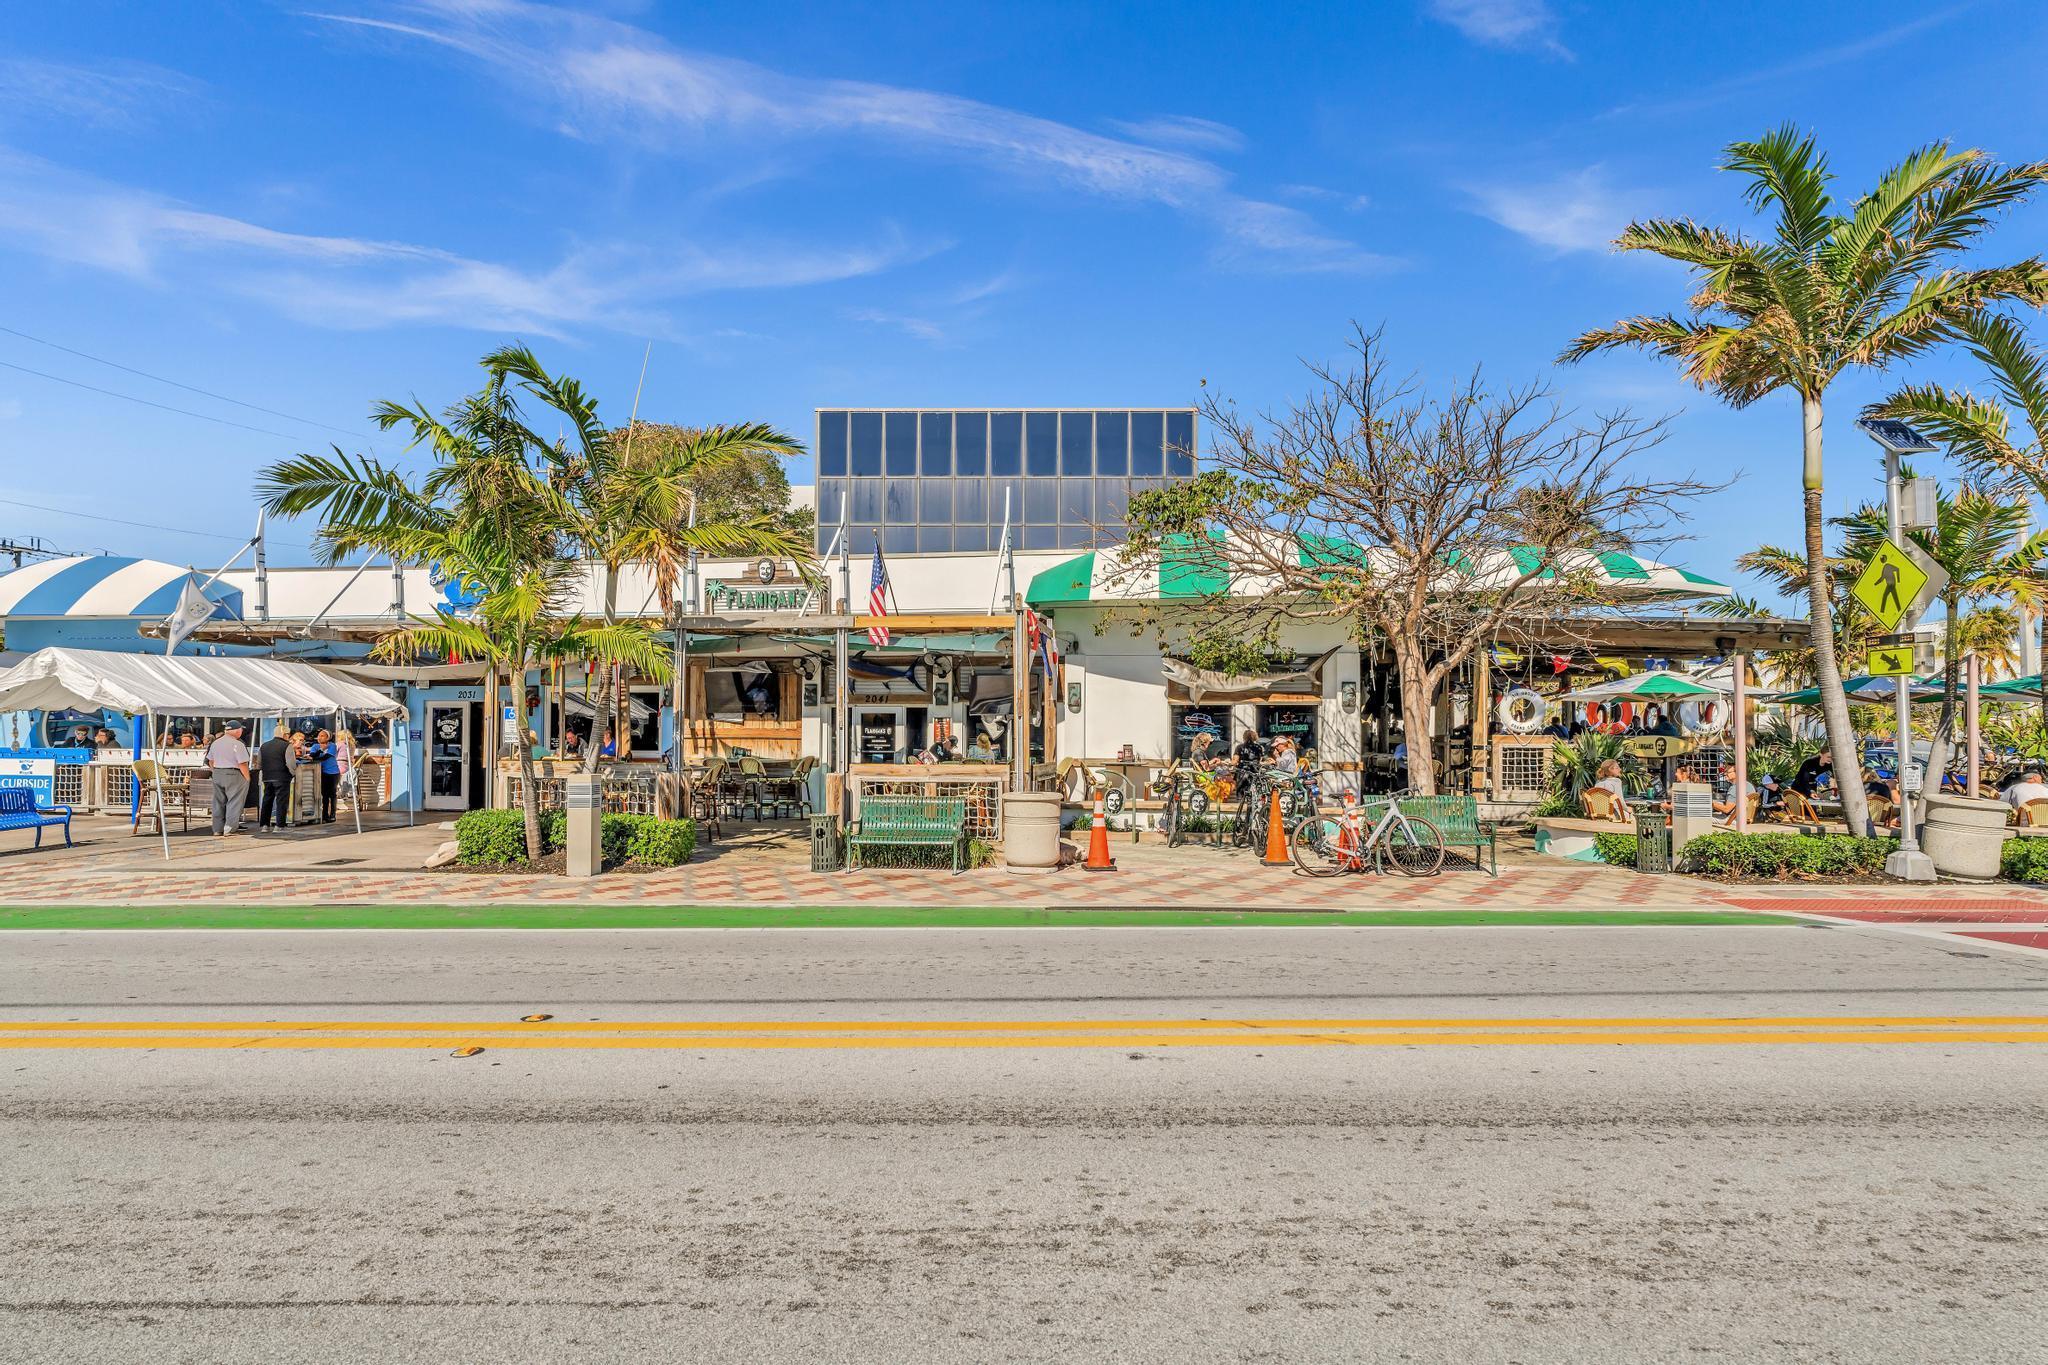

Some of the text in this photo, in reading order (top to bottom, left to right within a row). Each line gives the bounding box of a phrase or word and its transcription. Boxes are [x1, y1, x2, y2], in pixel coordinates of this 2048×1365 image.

[726, 588, 809, 611] FLANIGAN'S
[458, 691, 476, 699] 2031
[866, 695, 889, 703] 2041
[2, 778, 49, 788] CURBSIDE
